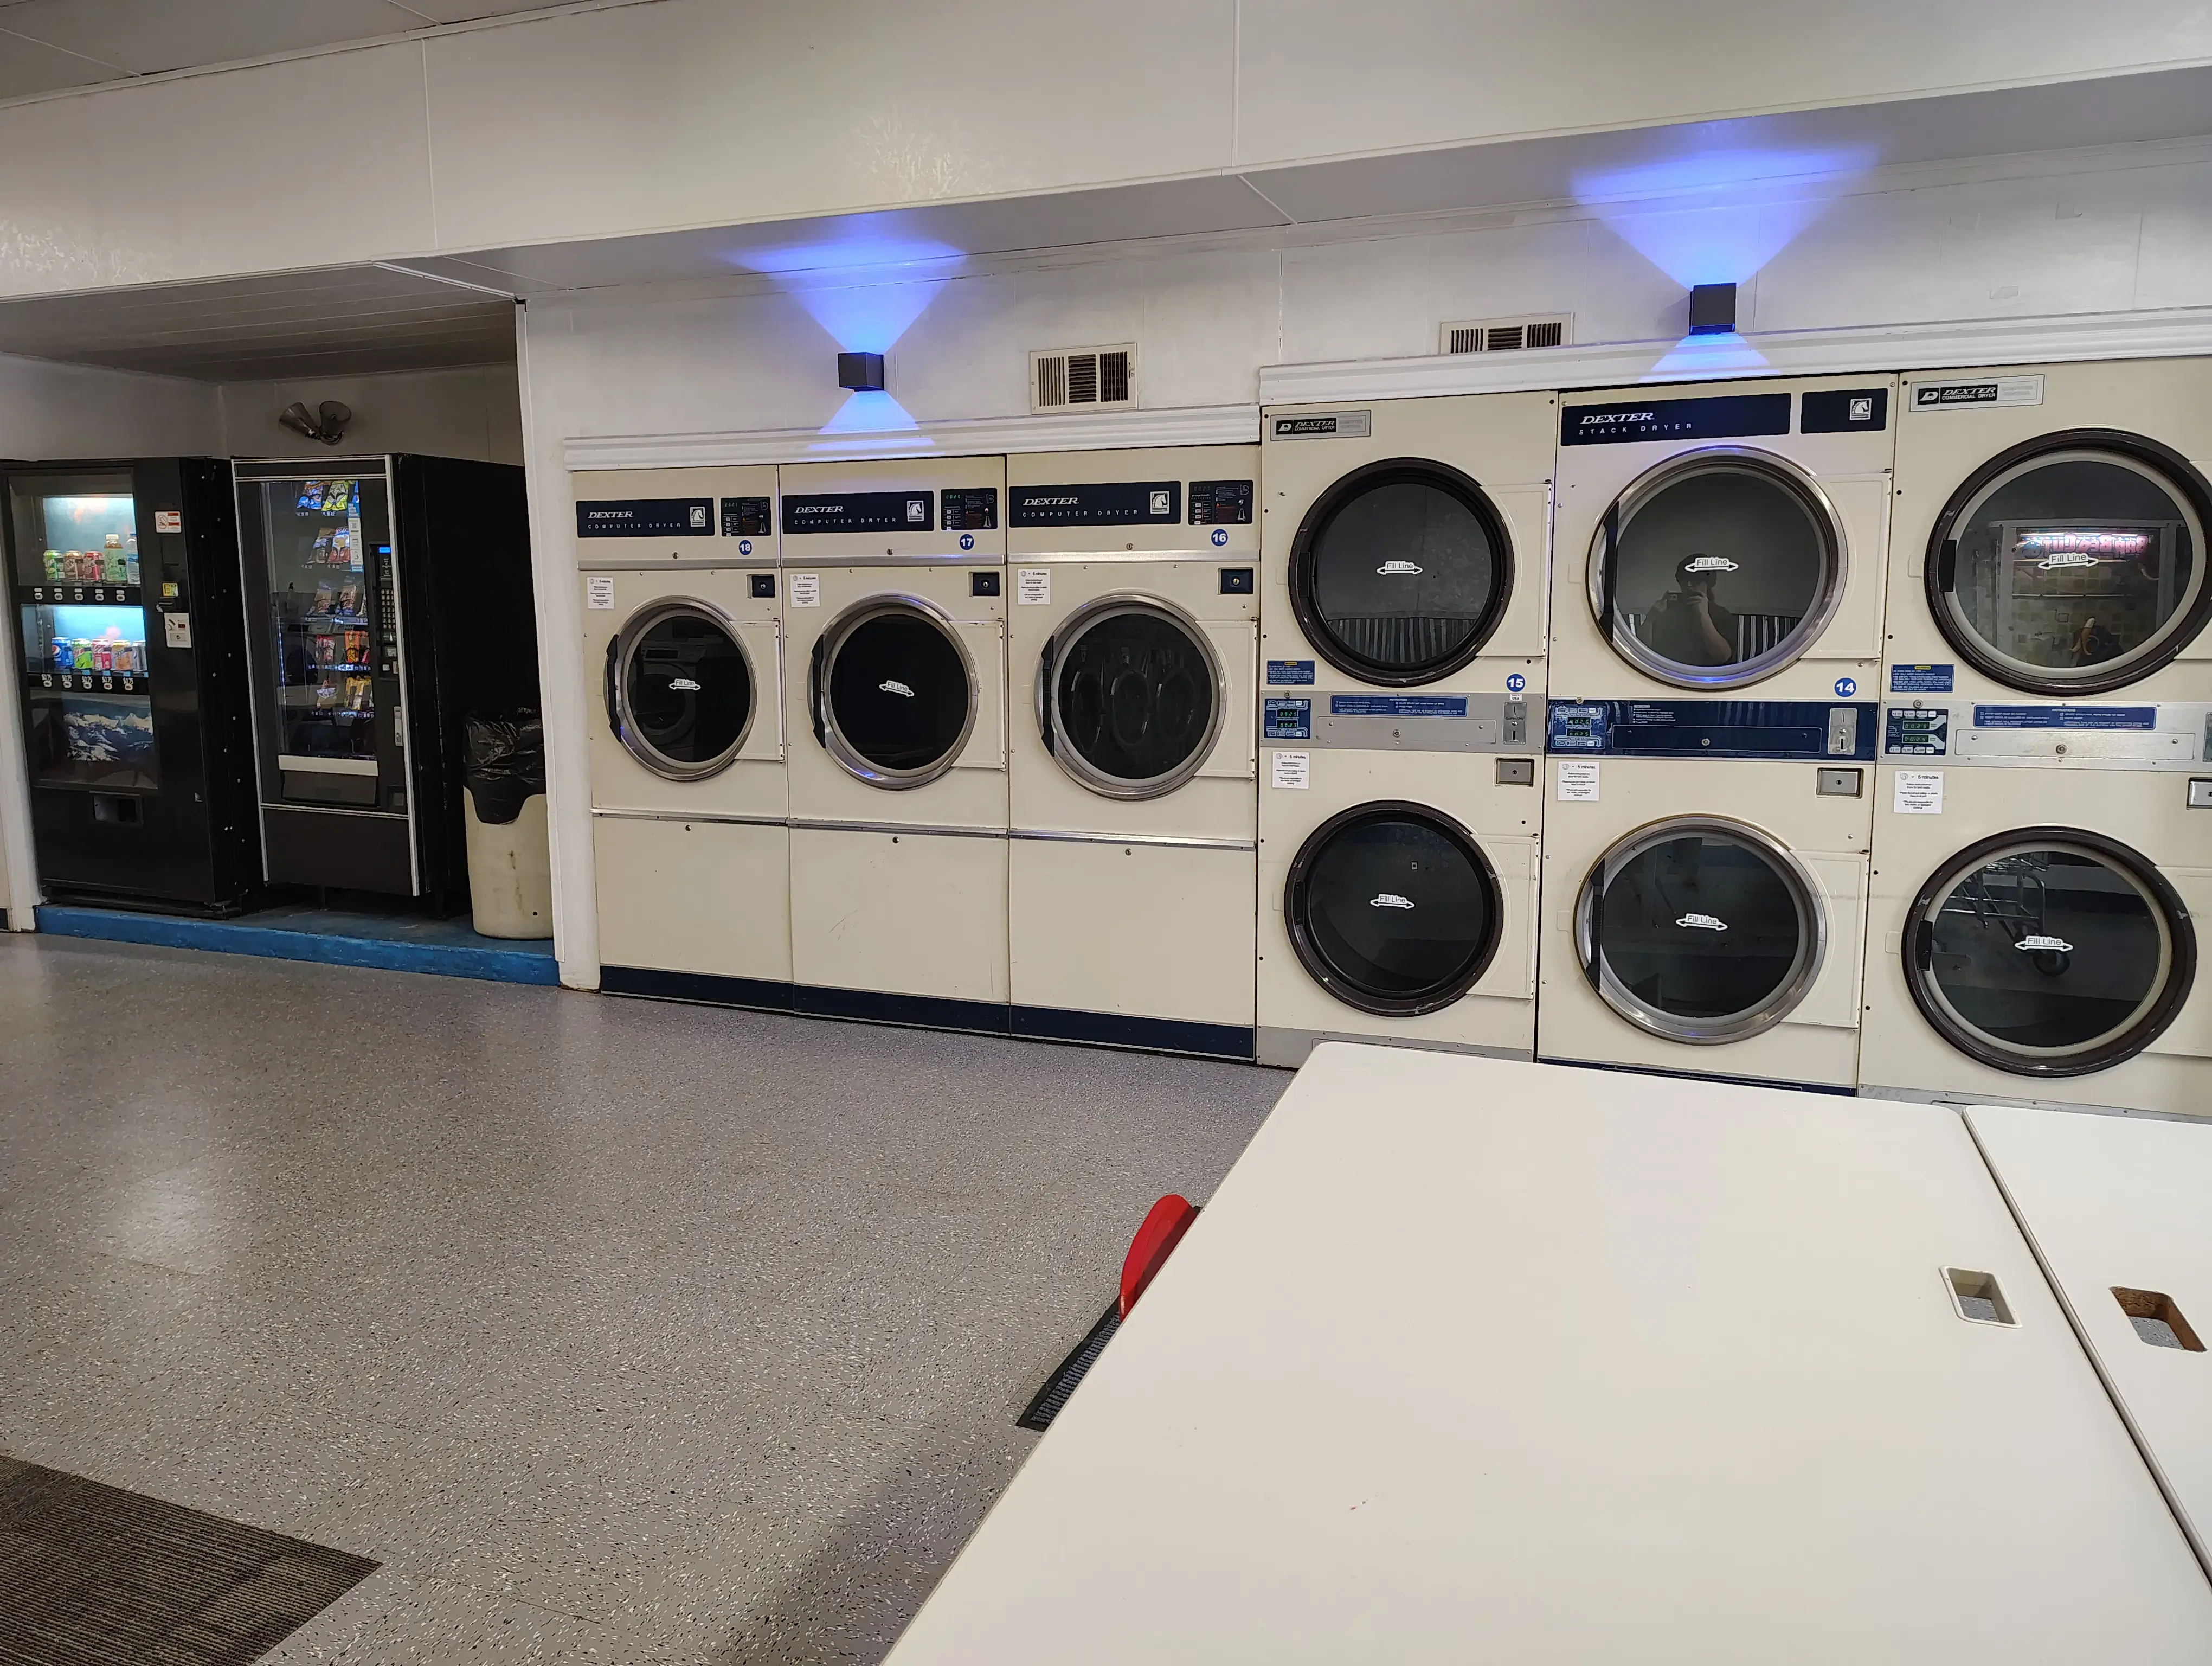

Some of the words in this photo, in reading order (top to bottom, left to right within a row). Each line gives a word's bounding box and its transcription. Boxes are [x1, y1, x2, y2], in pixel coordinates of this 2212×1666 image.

[1943, 387, 1996, 396] DEXTER
[1580, 412, 1654, 424] DEXTER
[1579, 427, 1627, 435] STACK
[1641, 423, 1692, 432] DRYER
[1023, 497, 1078, 505] DEXTER
[794, 505, 844, 514] DEXTER
[1212, 533, 1226, 542] 16
[961, 538, 973, 547] 17
[740, 543, 751, 552] 18
[2052, 555, 2064, 563] Fill
[2067, 554, 2086, 562] Line
[1508, 678, 1523, 688] 15
[1836, 682, 1855, 693] 14
